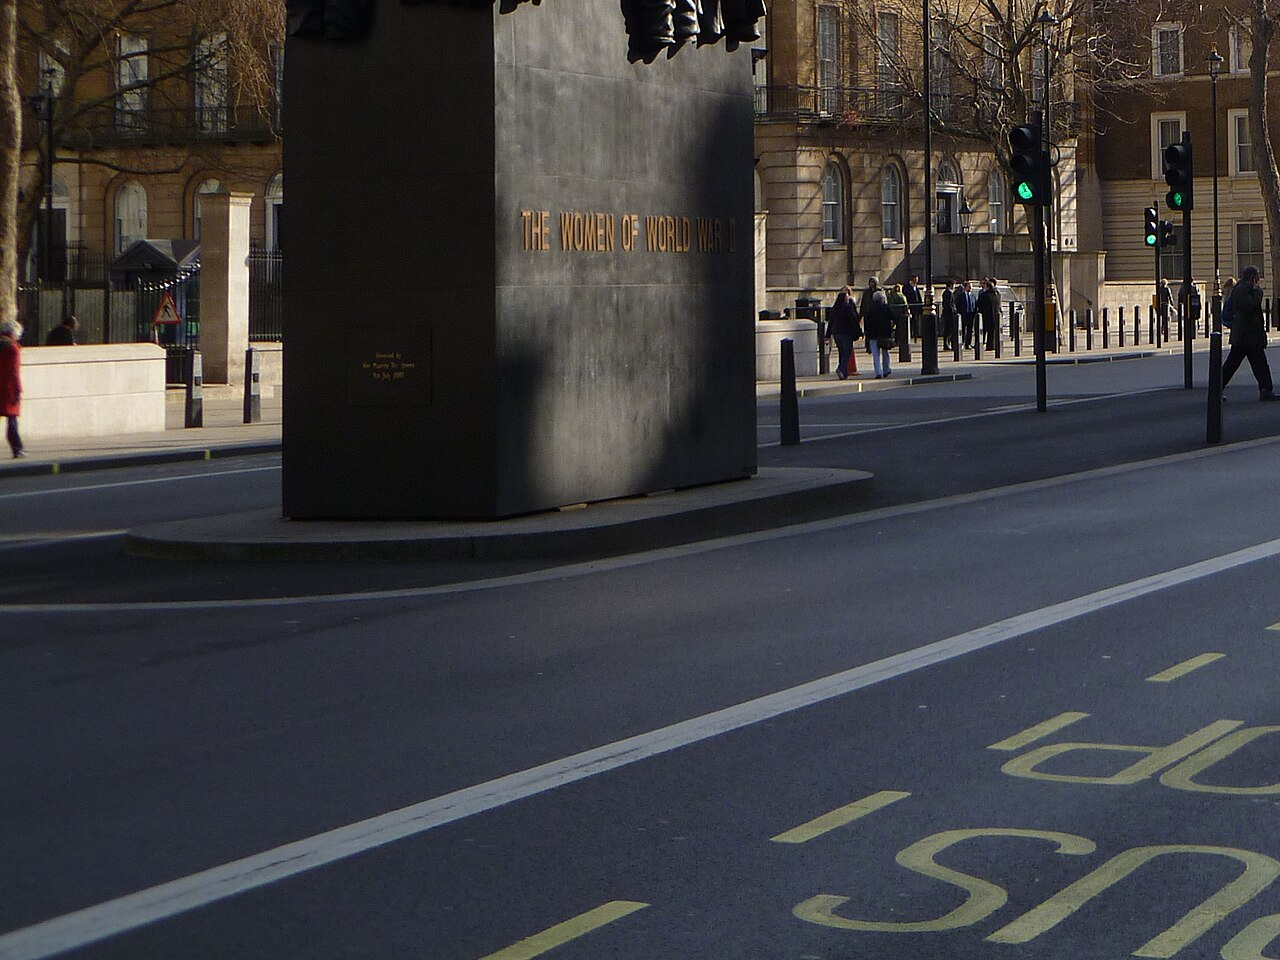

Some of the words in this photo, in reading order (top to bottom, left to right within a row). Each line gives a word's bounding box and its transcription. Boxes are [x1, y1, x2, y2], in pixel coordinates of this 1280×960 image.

[520, 209, 550, 251] THE
[559, 211, 616, 252] WOMEN
[620, 214, 639, 251] OF
[645, 215, 691, 253] WORLD
[696, 217, 721, 253] WAR
[728, 217, 737, 253] II
